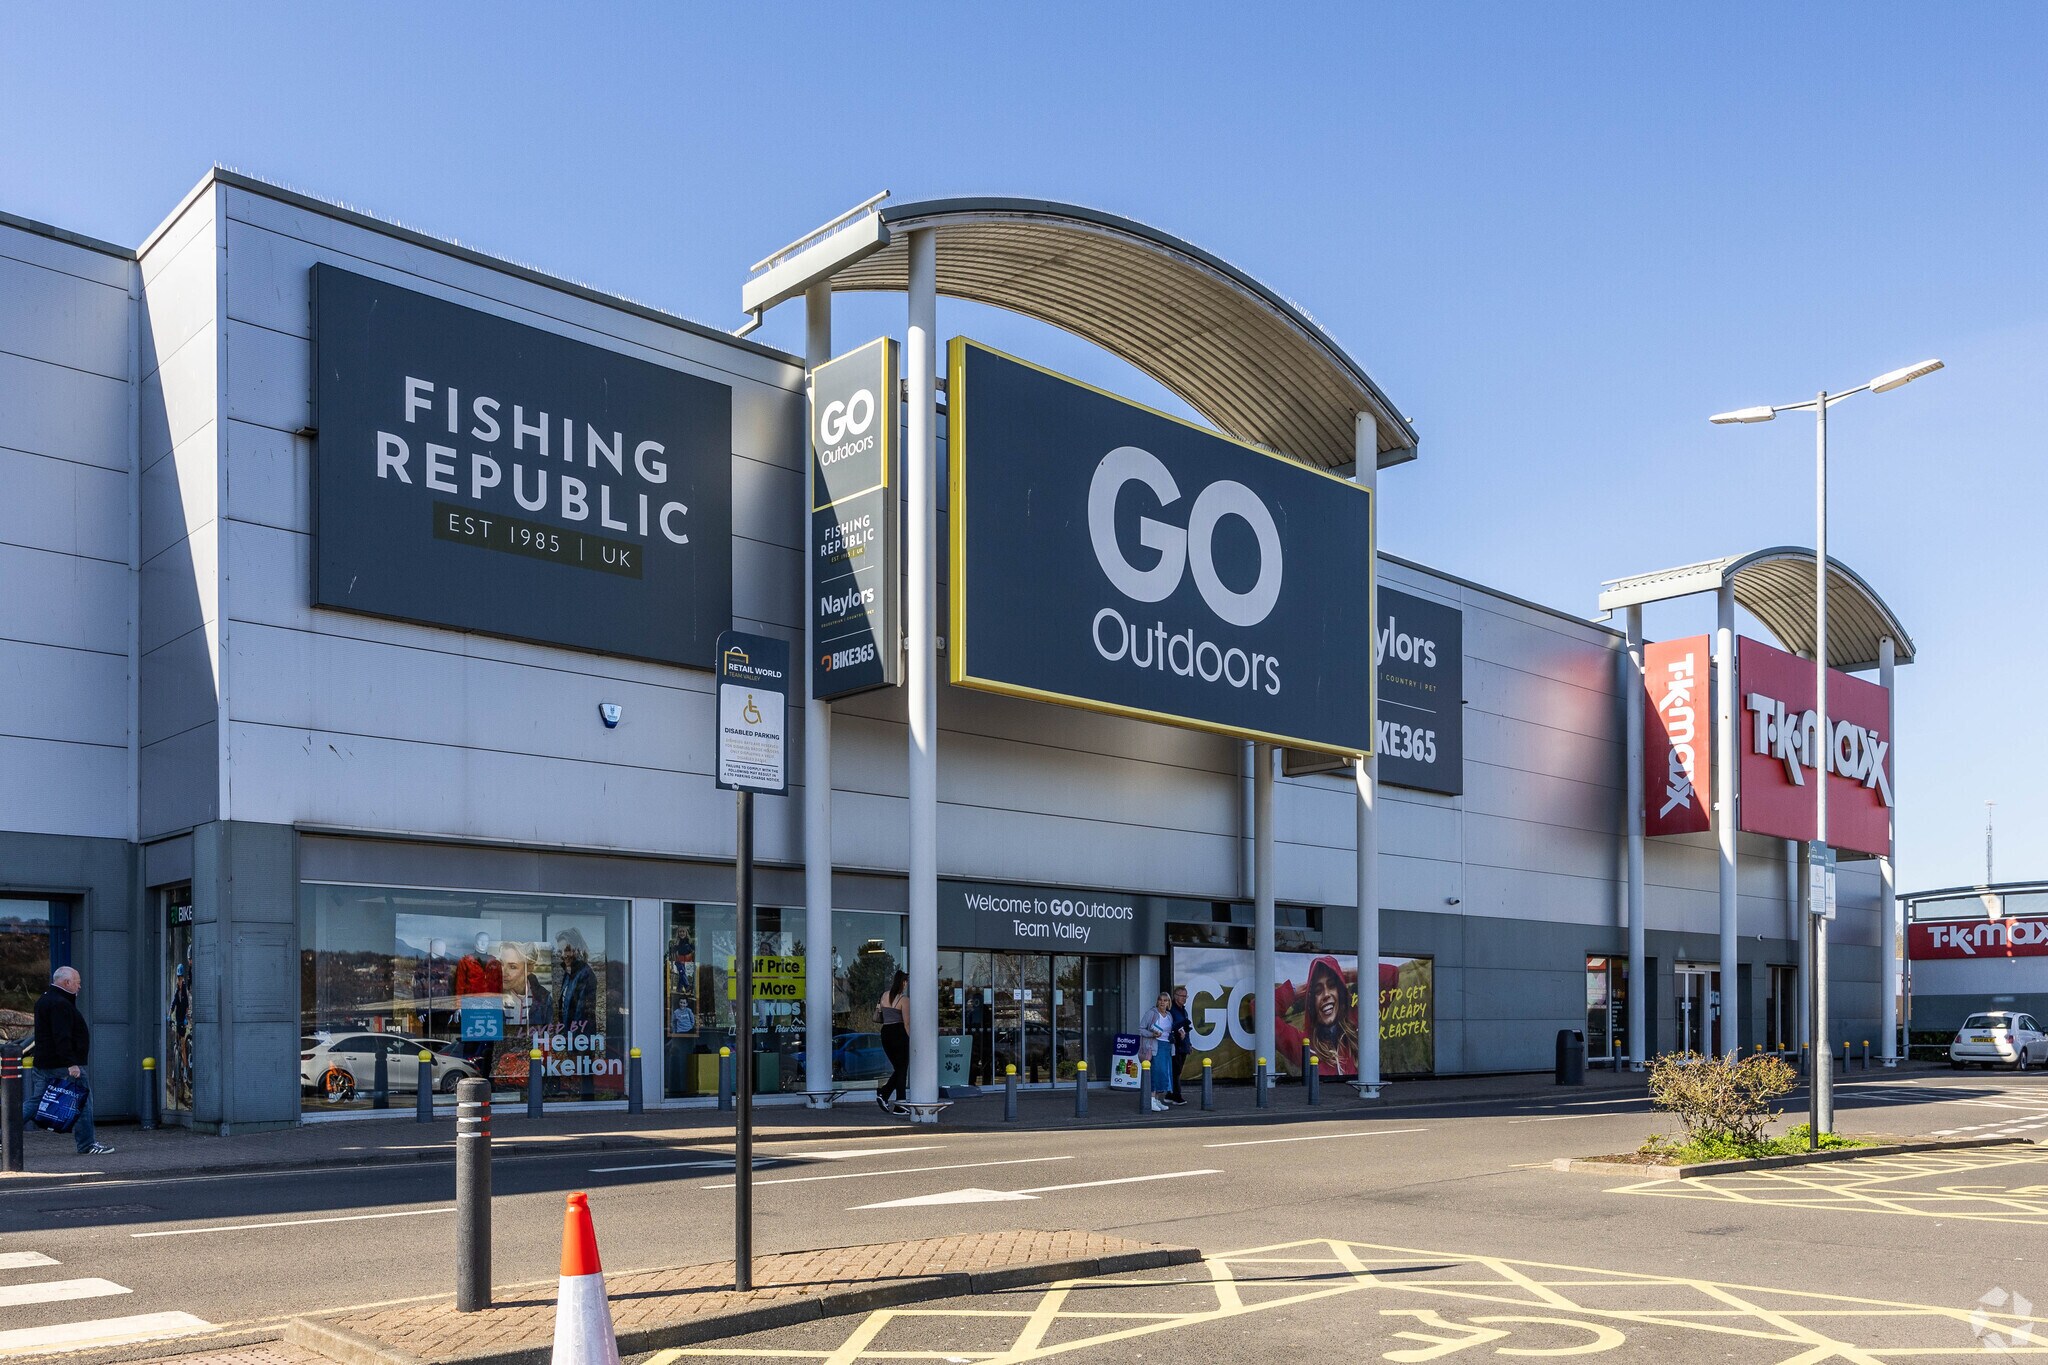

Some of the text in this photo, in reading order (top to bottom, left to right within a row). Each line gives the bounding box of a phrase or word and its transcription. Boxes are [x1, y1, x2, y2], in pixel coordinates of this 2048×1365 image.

[405, 375, 667, 484] FISHING
[820, 388, 875, 446] GO
[821, 435, 874, 467] Outdoors
[376, 430, 690, 545] REPUBLIC
[448, 513, 631, 568] EST 1985 UK
[825, 514, 870, 541] FISHING
[1087, 445, 1283, 627] GO
[820, 528, 874, 557] REPUBLIC
[821, 587, 875, 617] Naylors
[1092, 607, 1281, 696] Outdoors
[1376, 616, 1437, 668] ylors
[832, 643, 874, 670] BIKE365
[728, 663, 782, 678] RETAIL WORLD
[1385, 674, 1437, 693] COUNTRY PET
[724, 727, 780, 740] DISABLED PARKING
[1377, 719, 1437, 764] KE365
[964, 892, 1133, 920] Welcome to GO Outdoors
[1013, 919, 1091, 944] Team Valley
[768, 959, 800, 973] Price
[760, 982, 797, 996] More
[1389, 988, 1403, 1002] TO
[1406, 985, 1427, 1003] GET
[765, 1002, 801, 1016] KIDS
[1392, 1002, 1427, 1020] READY
[466, 1019, 498, 1038] £55
[569, 1020, 588, 1034] BY
[775, 1024, 790, 1033] Peter
[1388, 1020, 1430, 1038] EASTER
[532, 1031, 605, 1052] Helen
